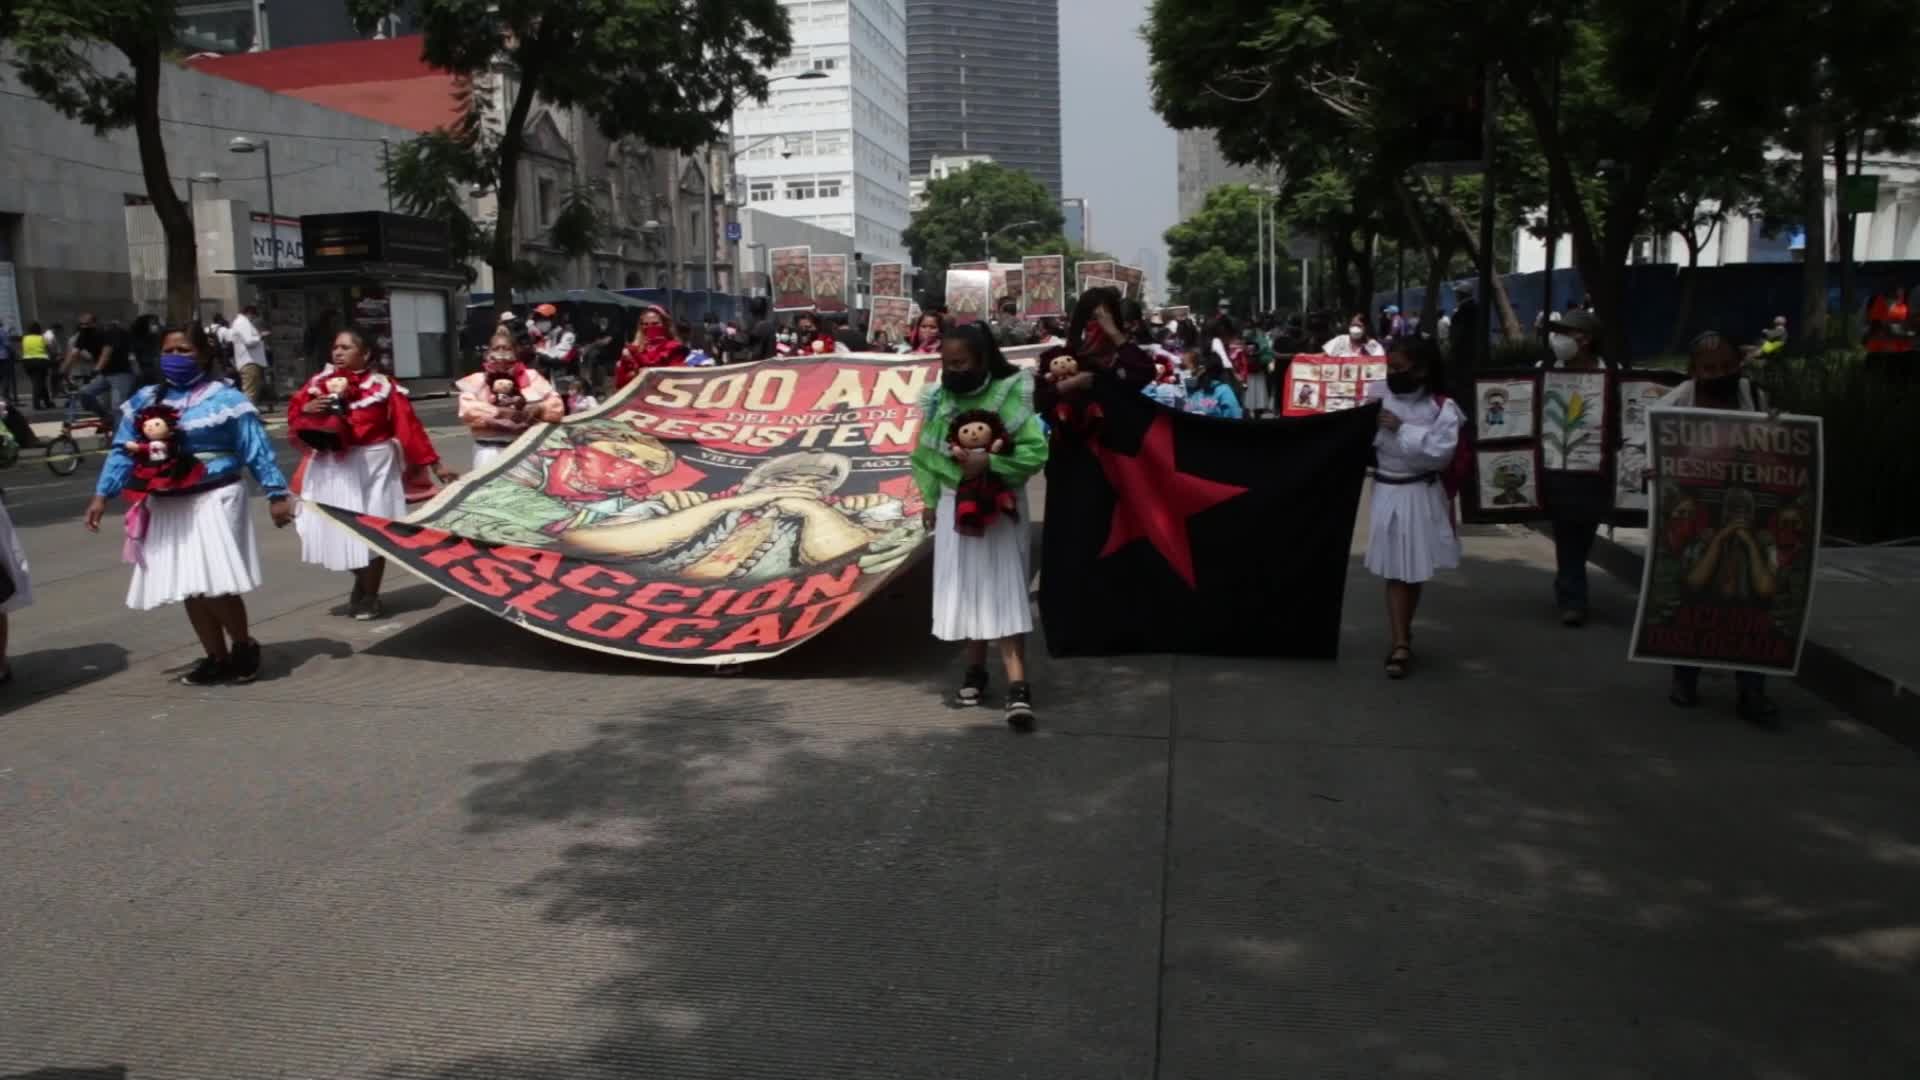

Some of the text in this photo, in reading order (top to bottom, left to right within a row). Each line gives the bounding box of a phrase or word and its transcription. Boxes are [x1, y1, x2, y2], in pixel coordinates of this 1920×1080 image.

[254, 237, 304, 259] NTRAD
[645, 365, 942, 412] 500 AÑ
[610, 410, 920, 447] RESISTEN
[726, 411, 771, 423] DEL
[780, 410, 861, 425] INICIO
[867, 408, 897, 420] DE
[1659, 416, 1716, 449] 500
[1661, 455, 1810, 488] RESISTENCIA
[355, 514, 863, 650] DISLOCAD
